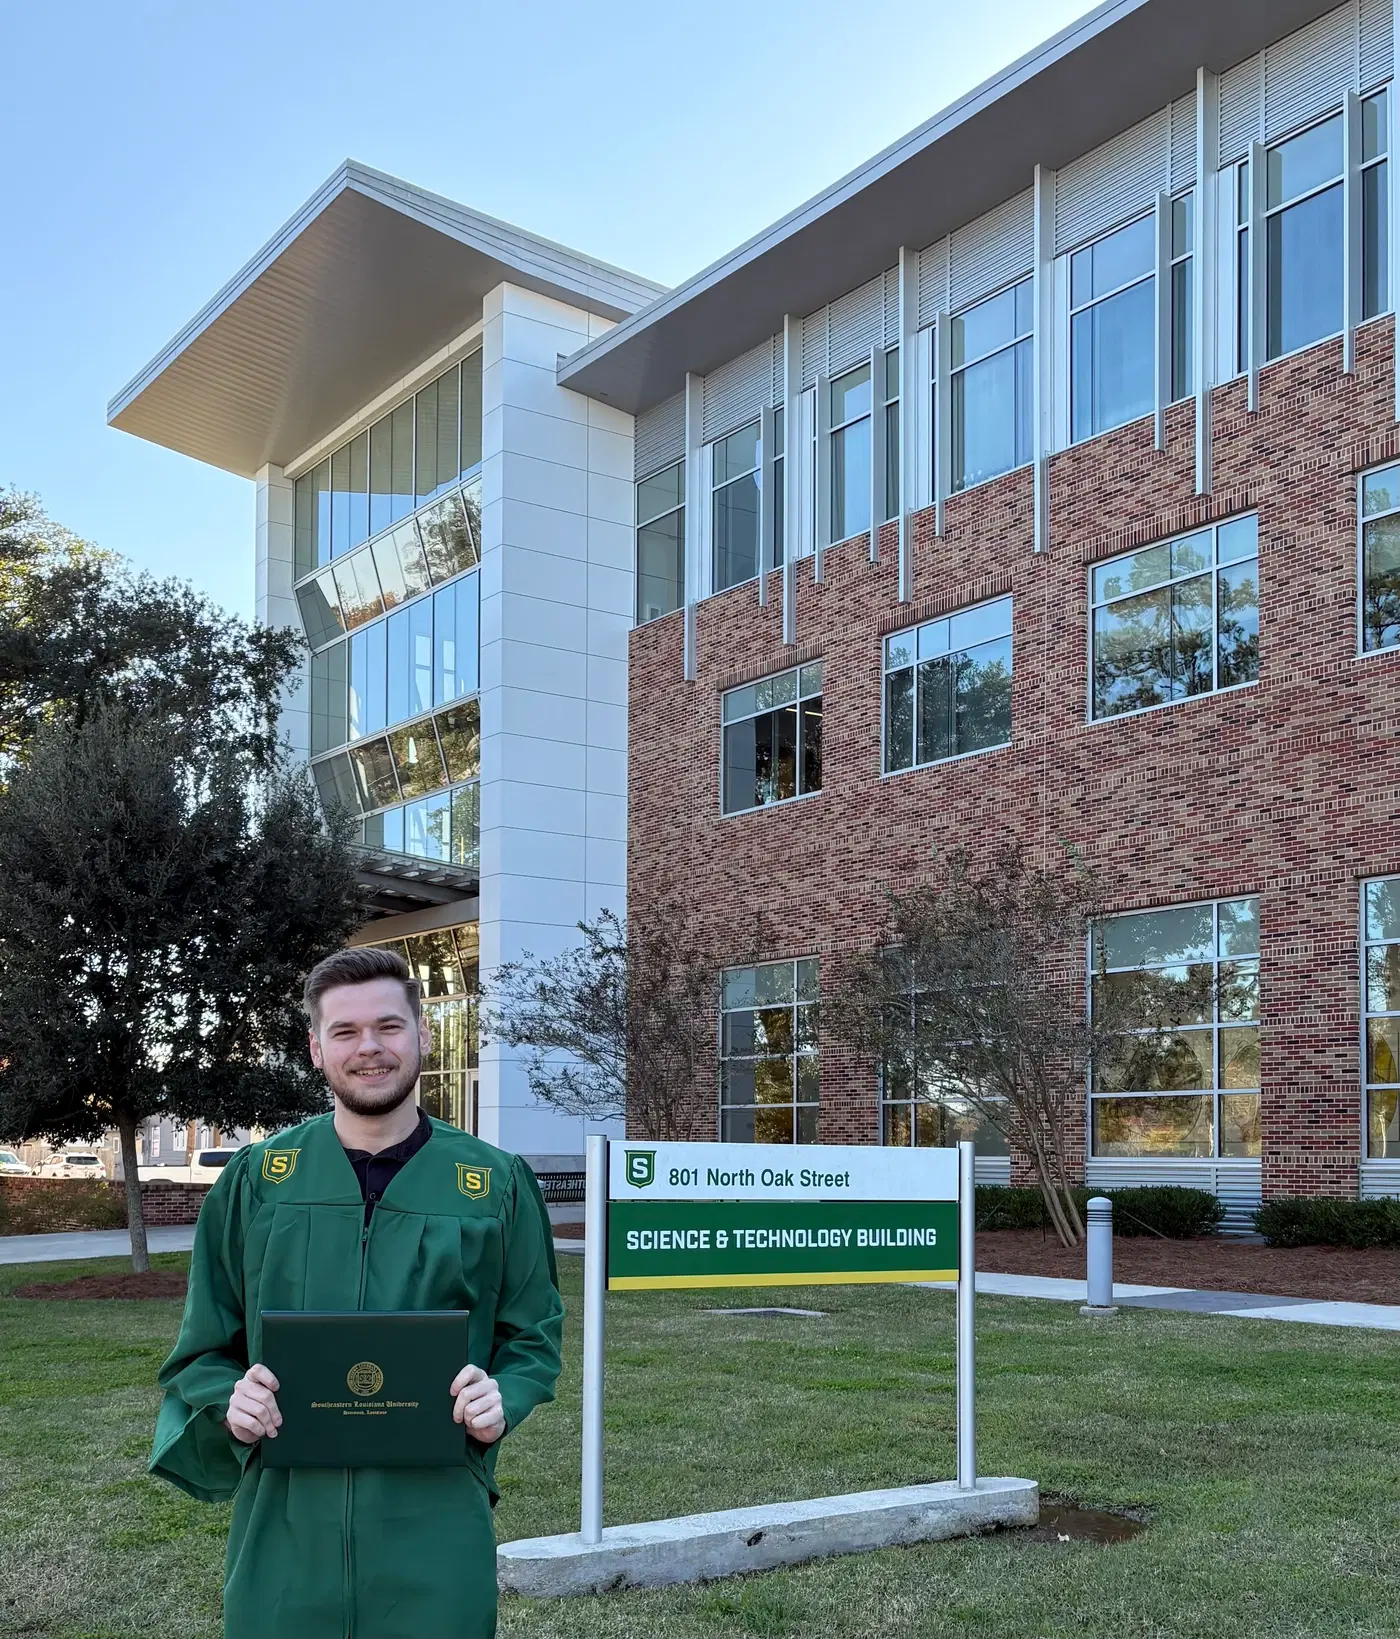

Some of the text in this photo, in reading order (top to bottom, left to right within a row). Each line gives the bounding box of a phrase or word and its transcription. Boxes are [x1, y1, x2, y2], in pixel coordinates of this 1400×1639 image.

[271, 1156, 287, 1173] S
[632, 1157, 649, 1179] S
[466, 1172, 482, 1190] S
[669, 1168, 850, 1188] 801 North Oak Street
[626, 1228, 937, 1250] SCIENCE & TECHNOLOGY BUILDING
